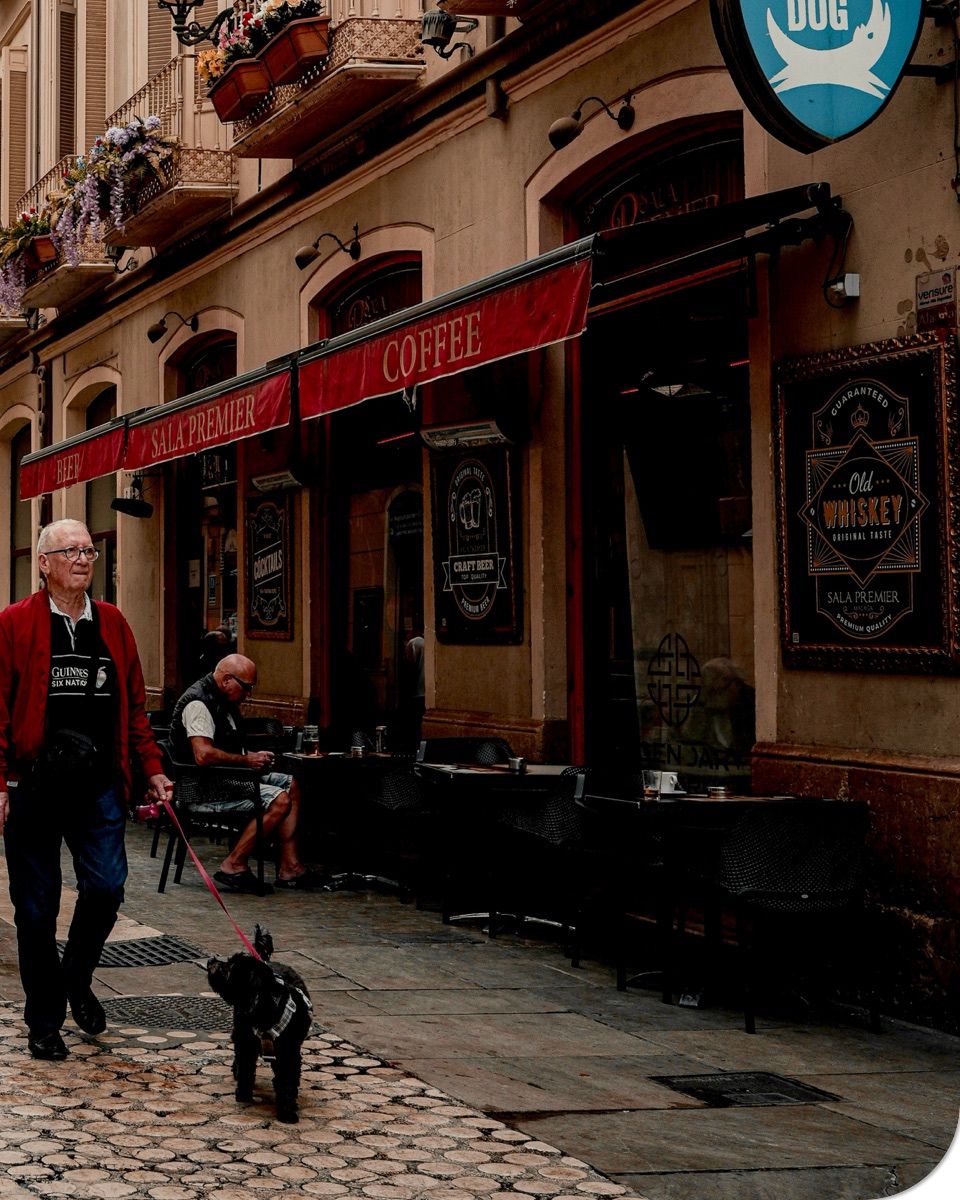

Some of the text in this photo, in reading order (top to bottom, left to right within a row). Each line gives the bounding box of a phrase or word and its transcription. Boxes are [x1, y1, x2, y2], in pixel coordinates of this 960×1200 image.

[382, 311, 482, 383] COFFEE
[830, 386, 889, 416] GUARANTEED
[151, 394, 256, 459] SALA PREMIER
[56, 453, 80, 484] BEER
[454, 467, 486, 487] ORIGINAL TASTE
[848, 470, 874, 495] Old
[823, 494, 903, 529] WHISKEY
[832, 530, 892, 542] ORIGINAL TASTE
[453, 559, 494, 573] CRAFT BEER
[460, 572, 488, 581] TOP QUALITY
[460, 594, 490, 613] PREMIUM BEER
[827, 590, 901, 604] SALA PREMIER
[836, 613, 893, 633] PREMIUM QUALITY
[51, 666, 89, 679] GUINNES
[51, 680, 64, 688] SIX
